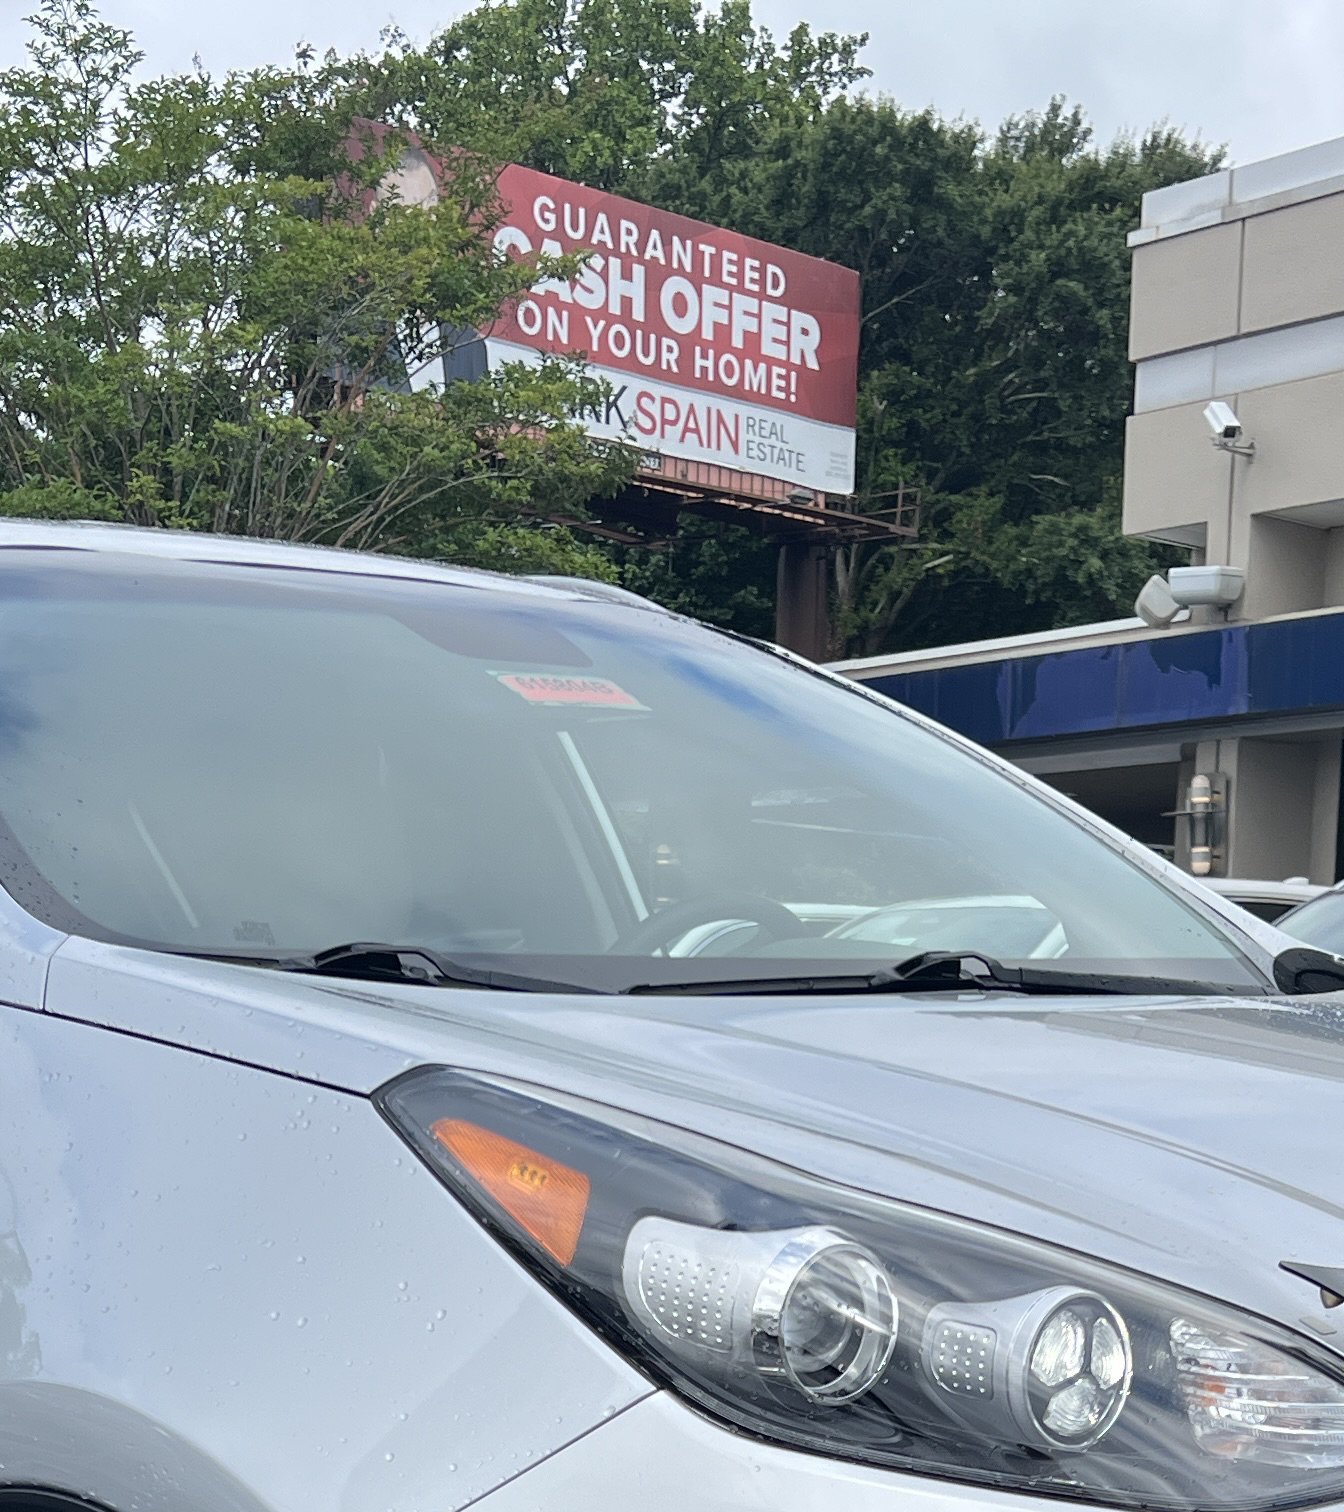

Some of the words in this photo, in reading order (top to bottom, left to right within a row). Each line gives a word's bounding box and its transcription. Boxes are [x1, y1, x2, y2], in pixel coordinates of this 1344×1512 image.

[533, 195, 787, 298] GUARANTEED
[517, 299, 569, 345] ON
[584, 315, 680, 374] YOUR
[694, 345, 797, 403] HOME!
[659, 275, 821, 371] OFFER
[634, 390, 740, 456] SPAIN
[746, 416, 790, 445] REAL
[746, 439, 806, 473] ESTATE
